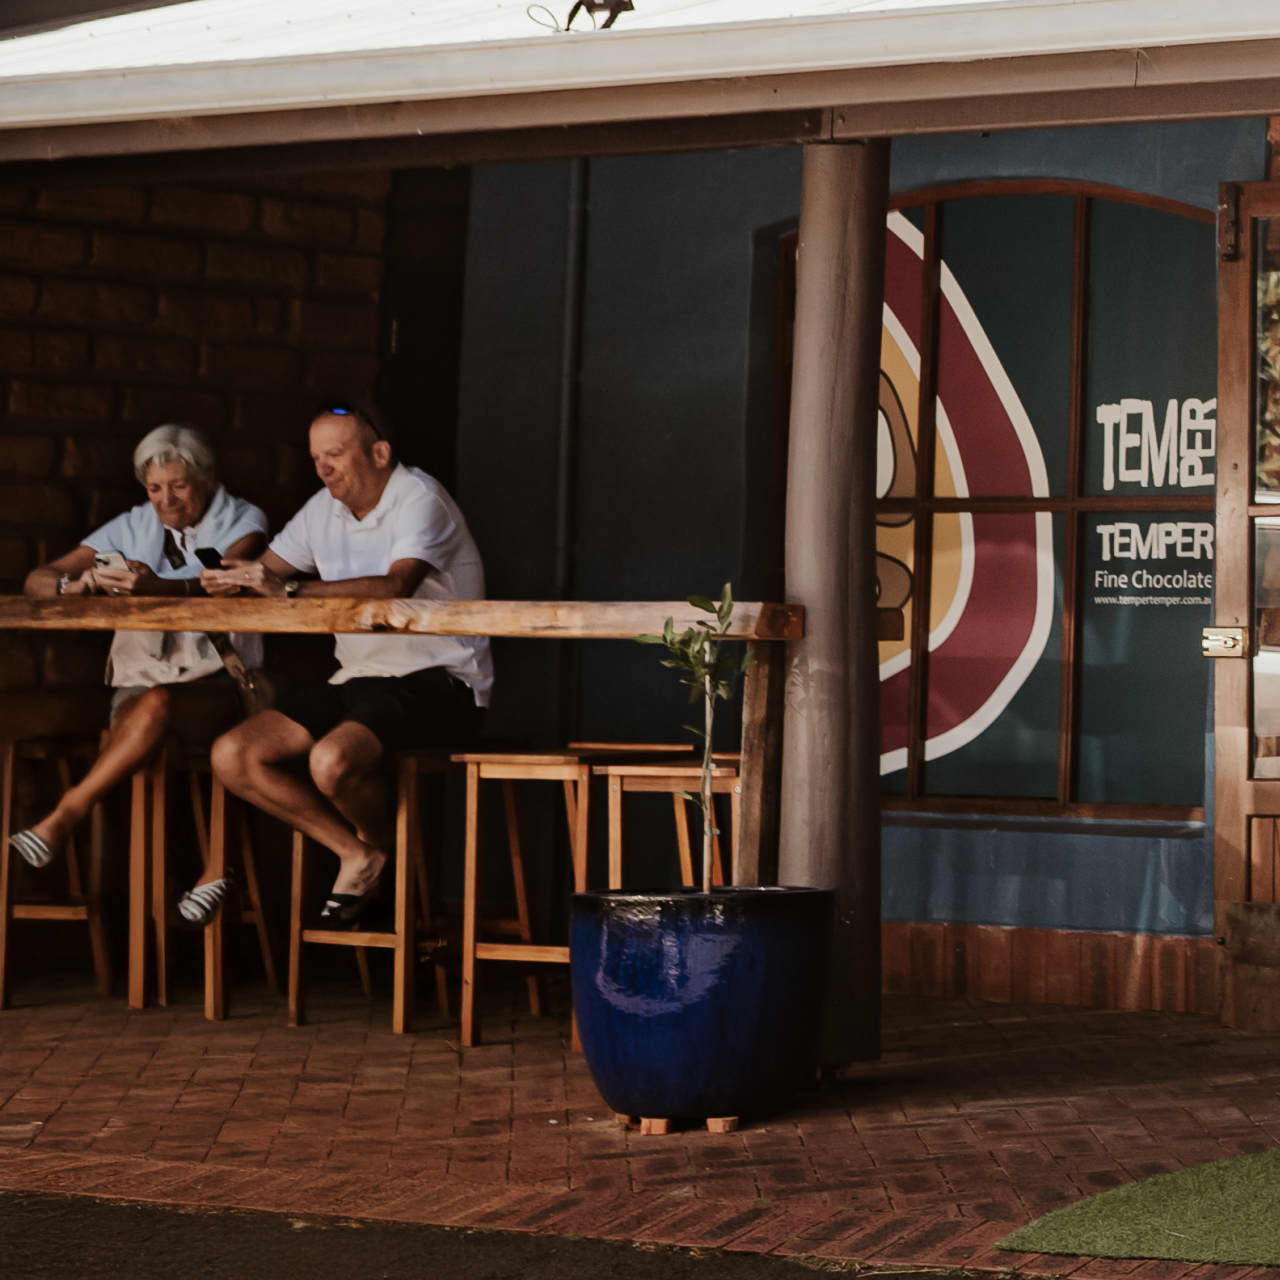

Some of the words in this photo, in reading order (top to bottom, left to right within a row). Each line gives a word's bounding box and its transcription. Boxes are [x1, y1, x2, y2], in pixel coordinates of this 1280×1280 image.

[1095, 521, 1215, 562] TEMPER
[1094, 569, 1129, 589] Fine
[1131, 568, 1213, 589] Chocolate
[1094, 594, 1212, 608] www.tempertemper.com.a
